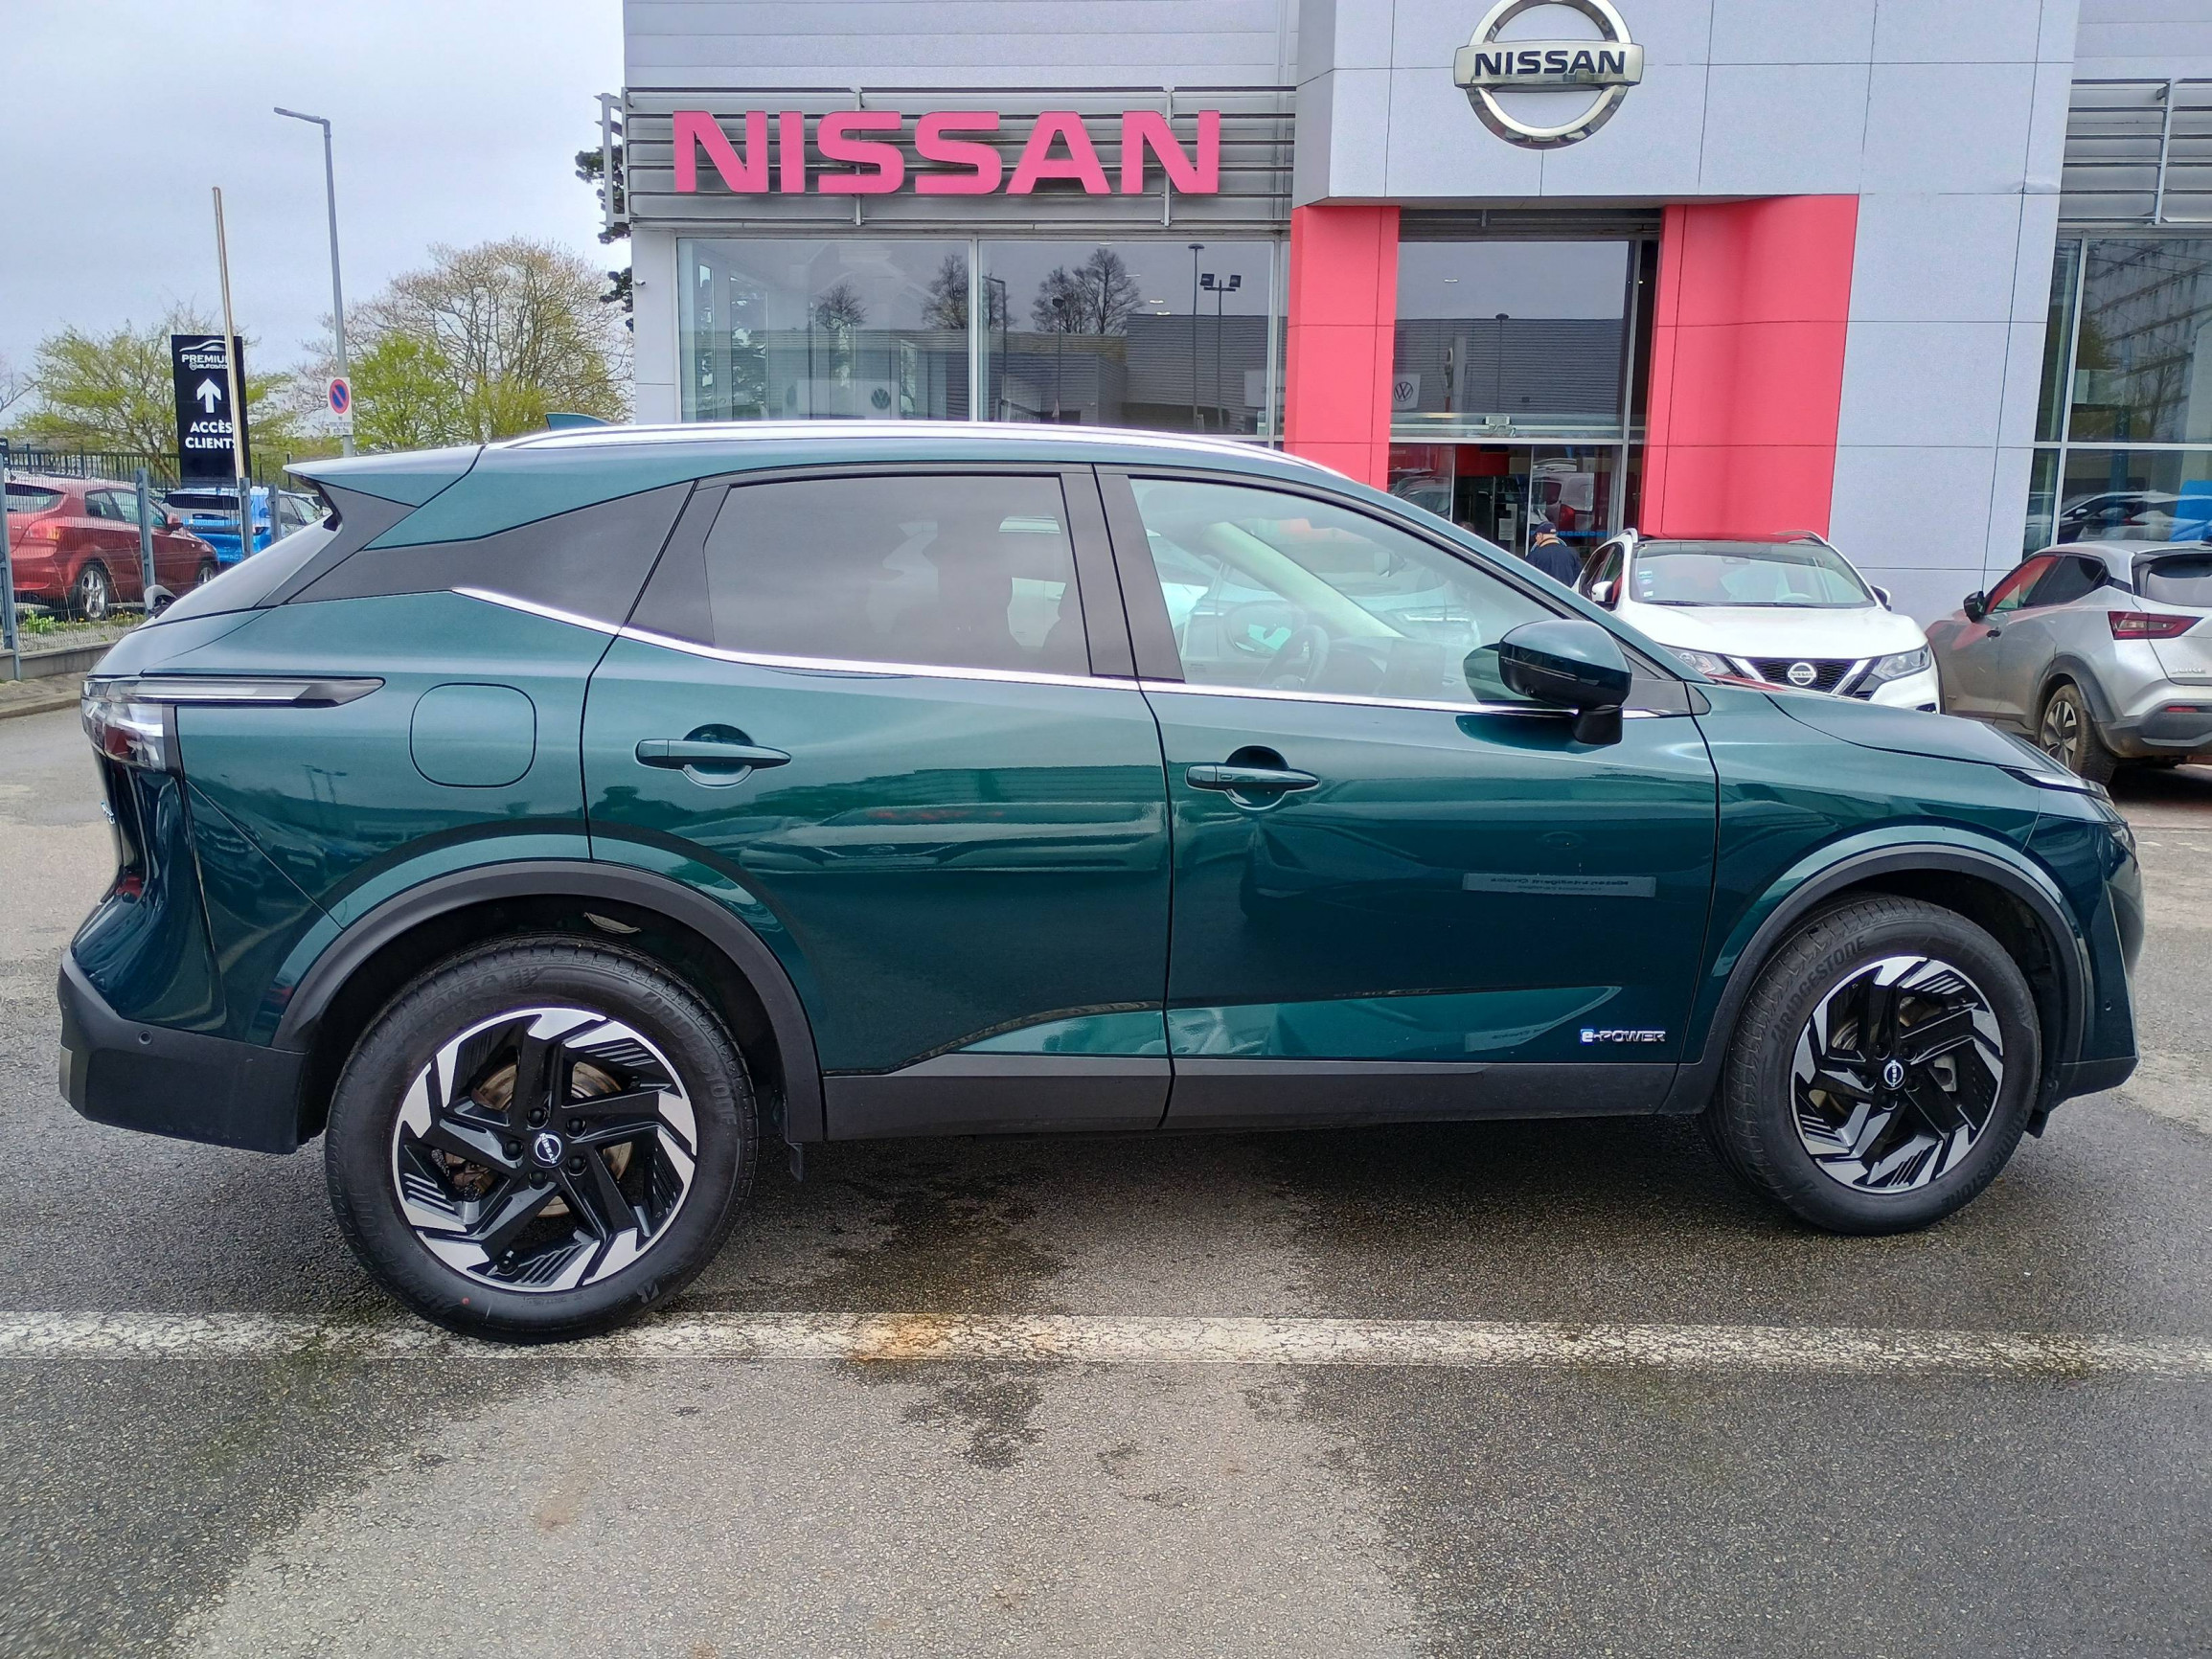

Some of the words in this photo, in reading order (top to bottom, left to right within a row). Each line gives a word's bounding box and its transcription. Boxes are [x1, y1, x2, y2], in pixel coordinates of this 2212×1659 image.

[1474, 50, 1626, 77] NISSAN
[673, 110, 1220, 194] NISSAN
[181, 353, 229, 364] PREMIU
[190, 419, 234, 434] ACCÈS
[185, 437, 236, 449] CLIENT
[1770, 935, 1866, 1045] BRIDGESTONE
[539, 1132, 558, 1165] NISSAN
